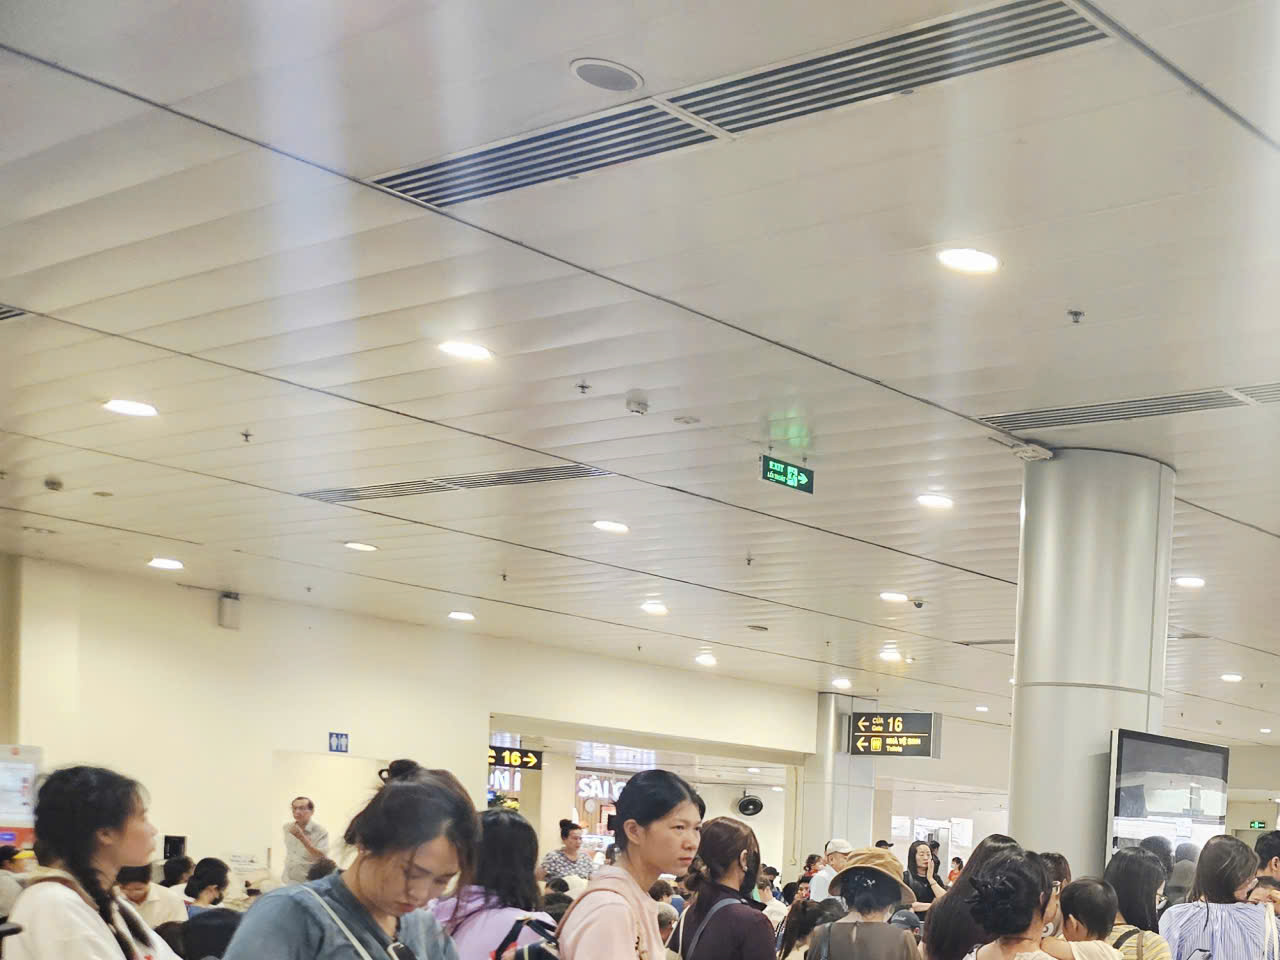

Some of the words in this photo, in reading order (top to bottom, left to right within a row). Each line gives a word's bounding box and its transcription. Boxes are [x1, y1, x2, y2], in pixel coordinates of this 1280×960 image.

[769, 461, 785, 473] EXIT
[887, 716, 903, 732] 16
[502, 750, 521, 765] 16
